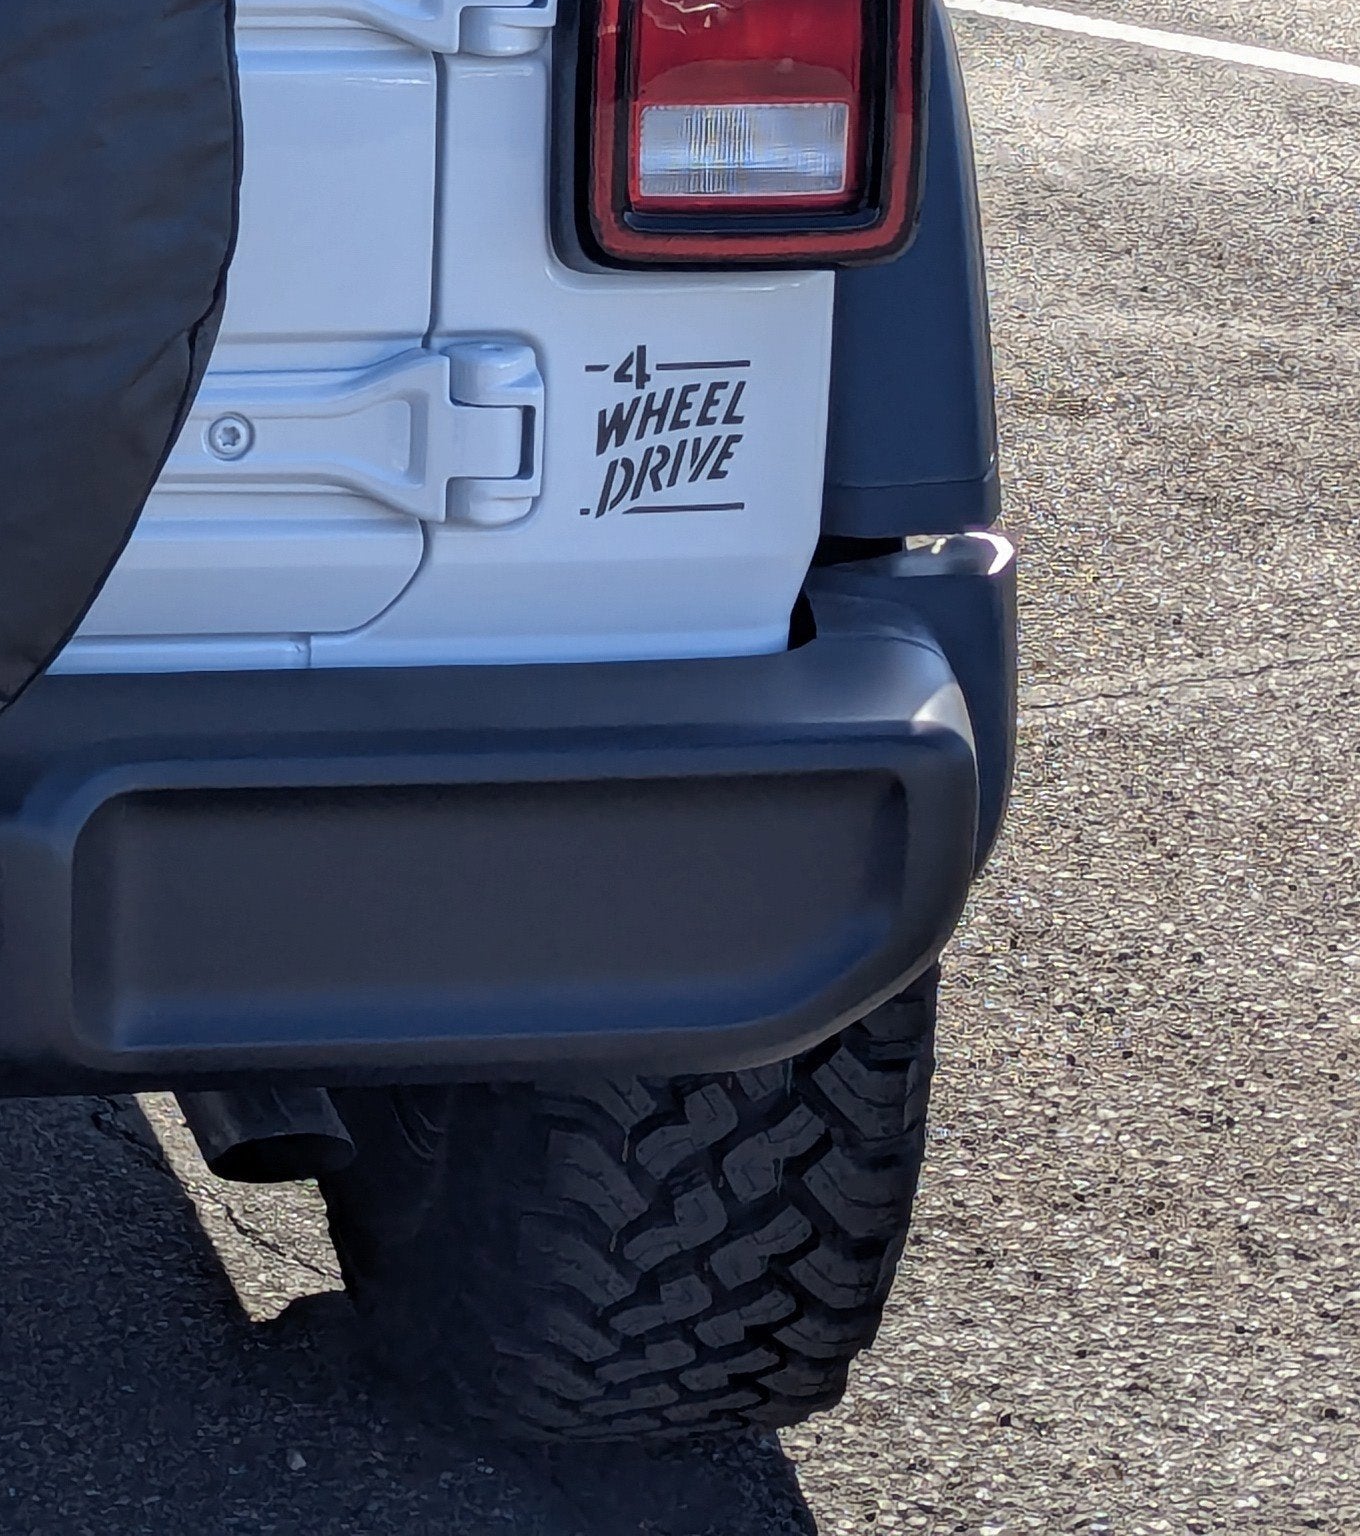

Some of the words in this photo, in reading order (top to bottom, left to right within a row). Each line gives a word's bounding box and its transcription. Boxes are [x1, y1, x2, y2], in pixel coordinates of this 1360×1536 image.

[613, 345, 651, 390] 4
[596, 380, 747, 457] WHEEL
[595, 434, 744, 519] DRIVE
